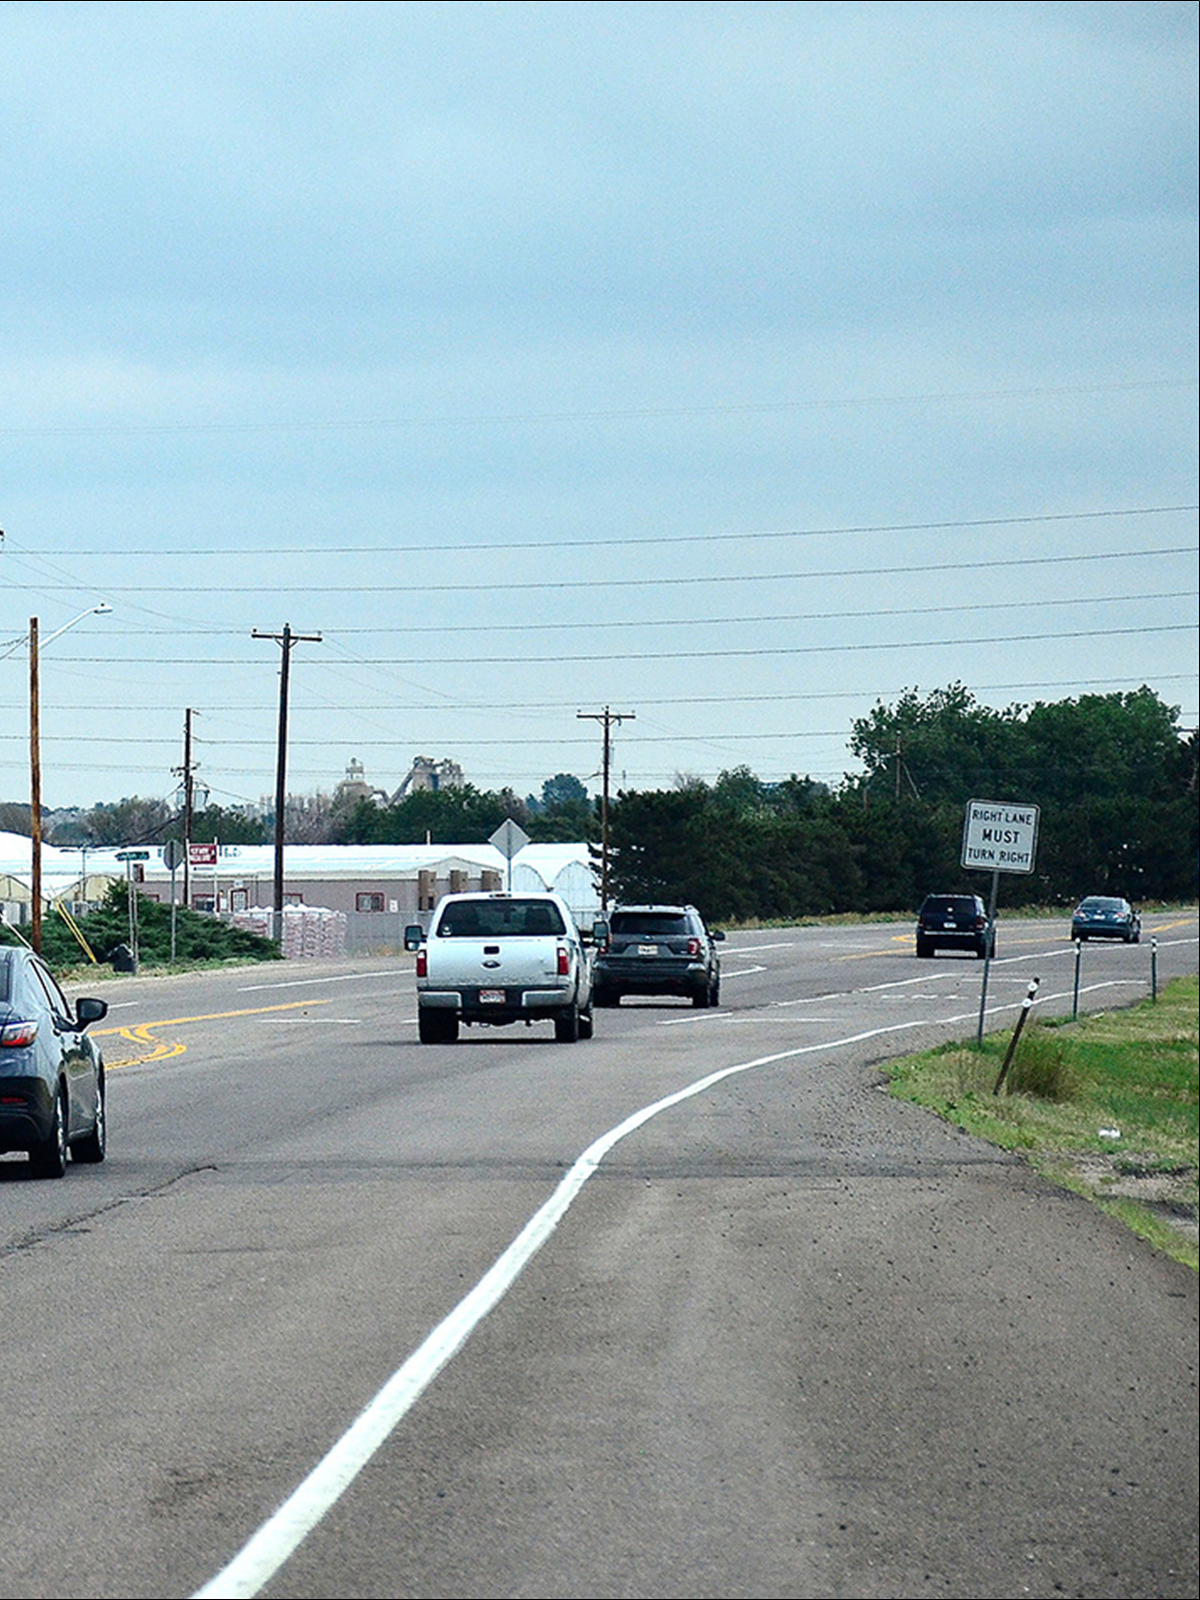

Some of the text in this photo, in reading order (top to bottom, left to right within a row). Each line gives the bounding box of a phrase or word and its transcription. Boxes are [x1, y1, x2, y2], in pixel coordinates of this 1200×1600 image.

[972, 809, 1033, 826] RIGHT LANE
[982, 828, 1020, 844] MUST
[968, 847, 1030, 864] TURN RIGHT
